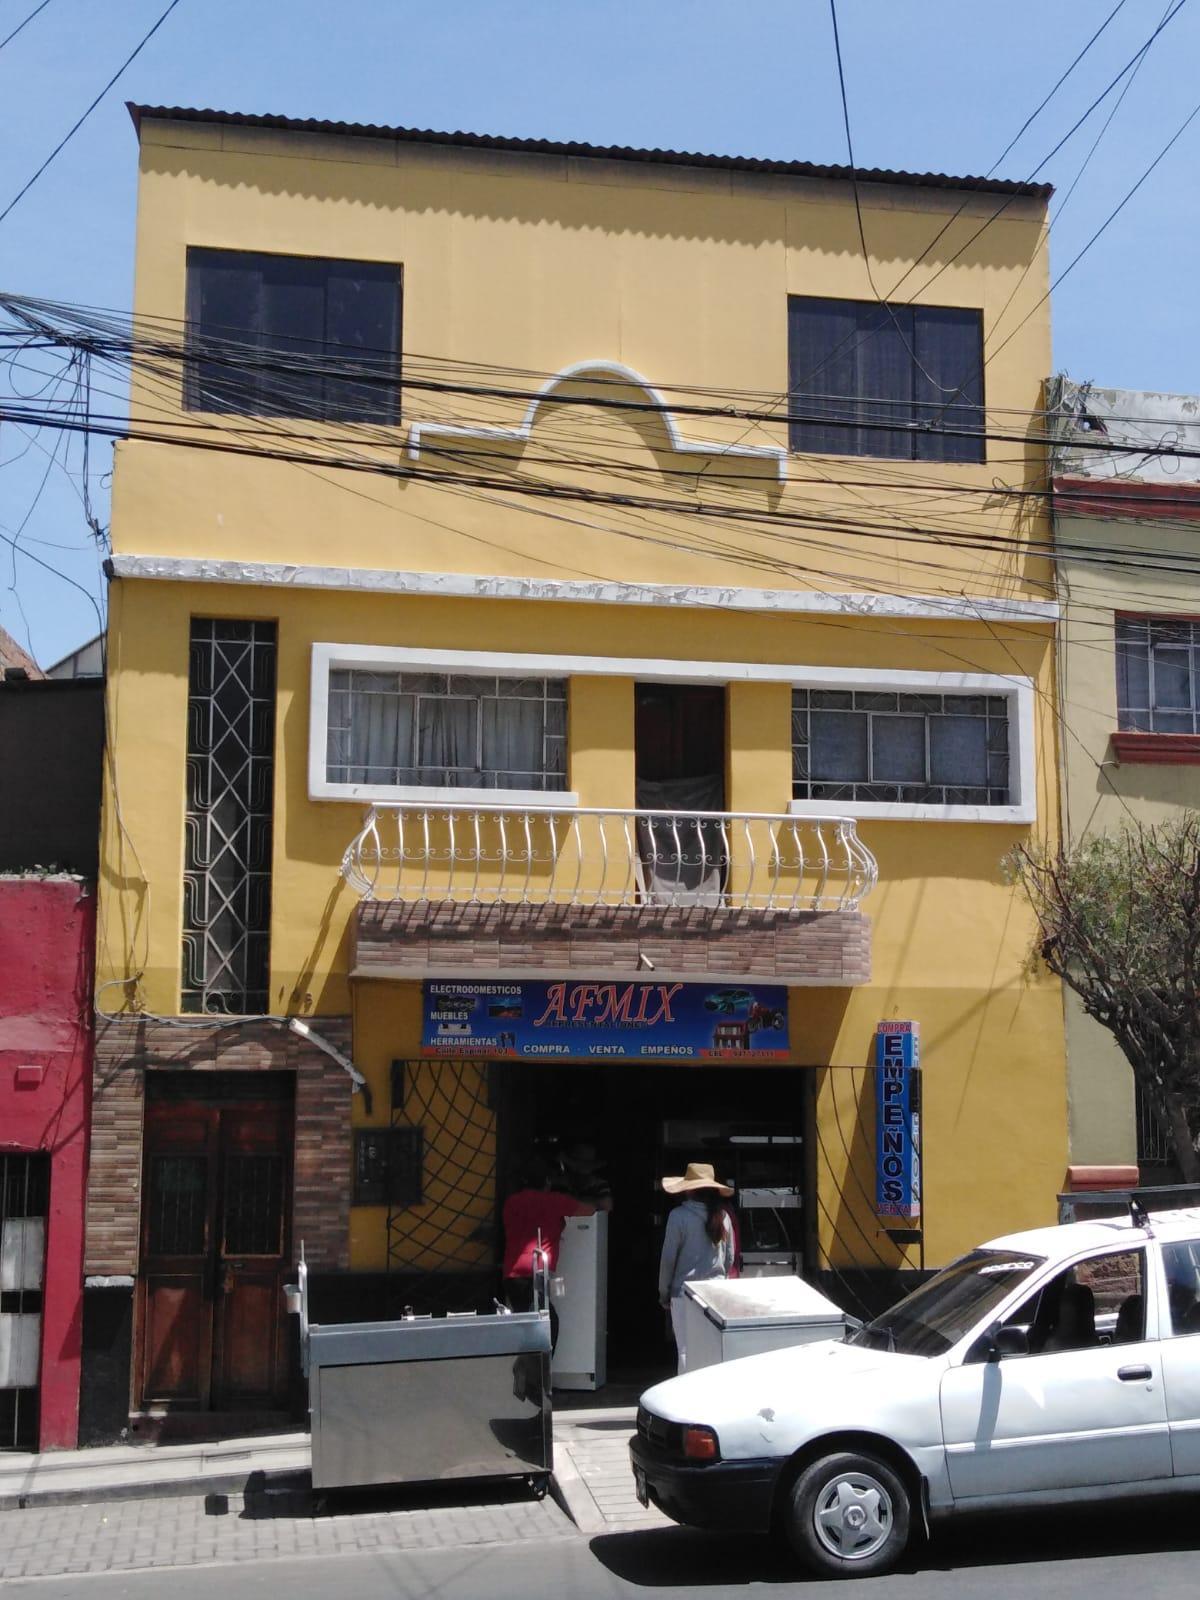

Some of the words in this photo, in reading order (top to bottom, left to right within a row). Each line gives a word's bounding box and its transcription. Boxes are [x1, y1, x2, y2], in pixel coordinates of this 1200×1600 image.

[430, 984, 522, 995] ELECTRODOMESTICOS
[533, 983, 684, 1026] AFMIX
[430, 1011, 469, 1020] MUEBLES
[878, 1022, 912, 1033] COMPRA
[430, 1037, 498, 1046] HERRAMIENTAS
[523, 1044, 570, 1054] COMPRA
[588, 1045, 625, 1055] VENTA
[640, 1043, 695, 1055] EMPEÑOS
[883, 1034, 904, 1202] EMPEÑOS
